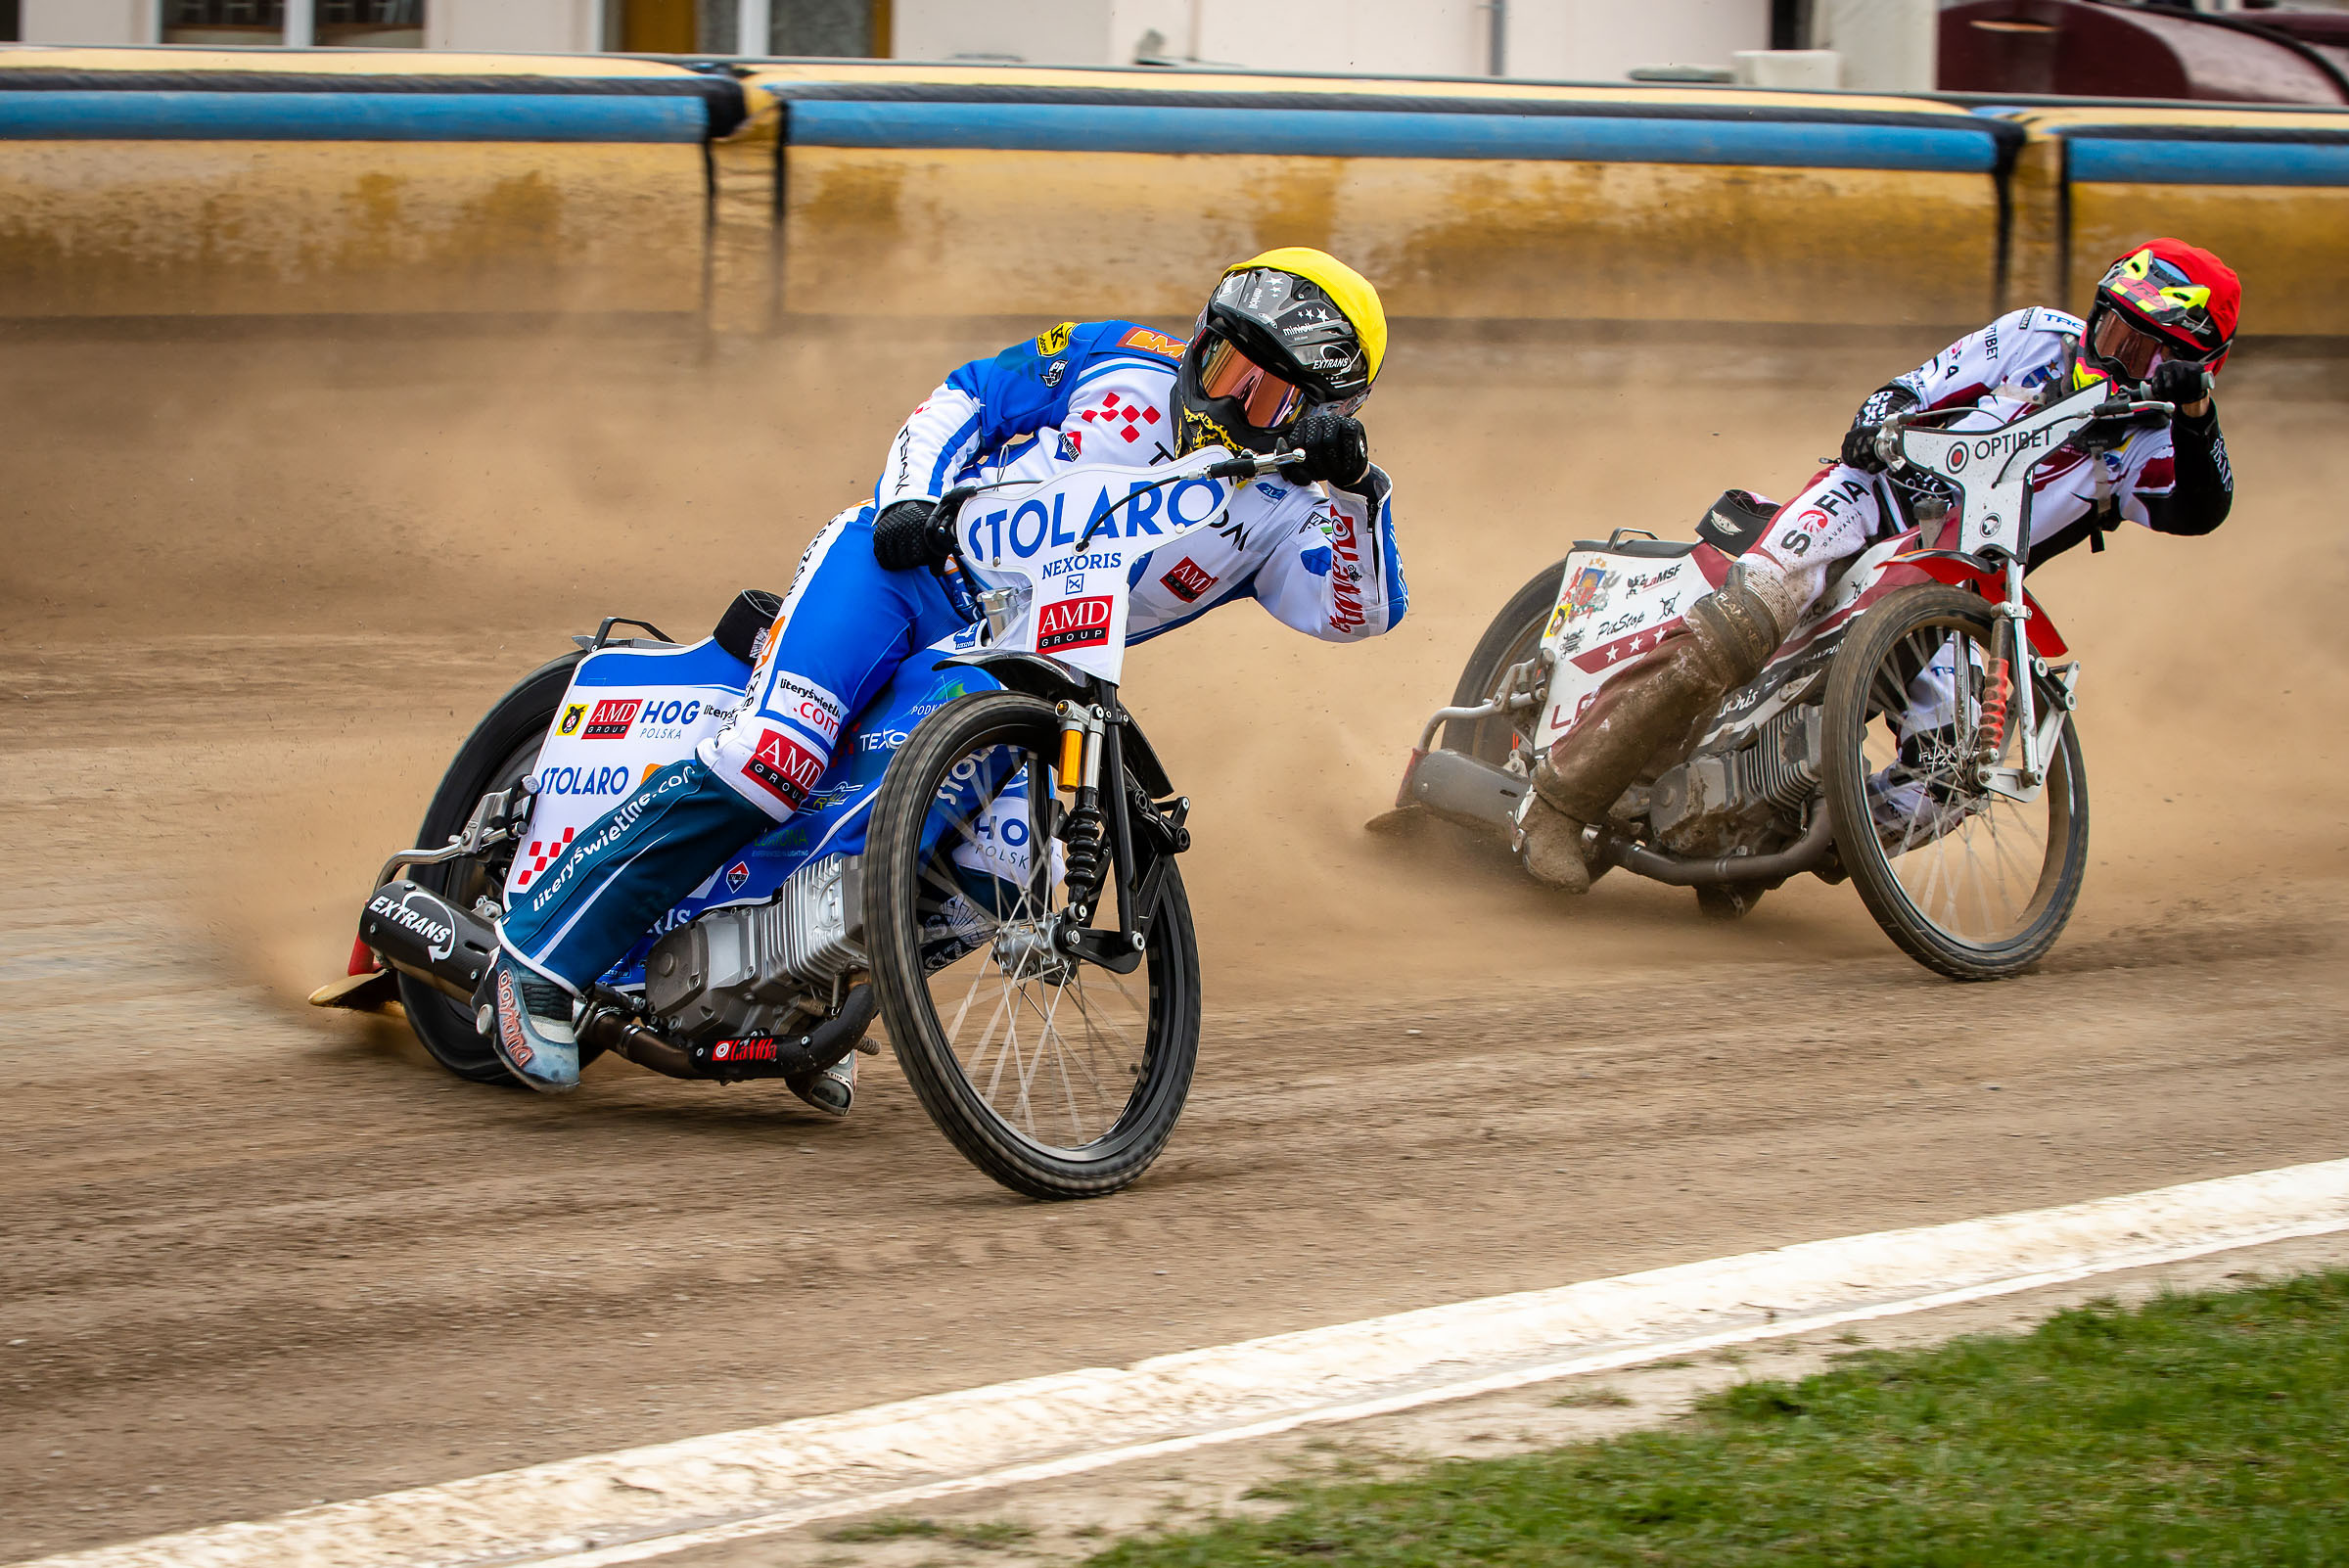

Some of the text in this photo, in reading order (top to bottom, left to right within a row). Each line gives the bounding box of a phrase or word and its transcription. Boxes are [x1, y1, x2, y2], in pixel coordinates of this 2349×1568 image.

[1984, 324, 1999, 361] TIBET
[1312, 357, 1349, 370] EXTRANS
[1974, 426, 2053, 460] OPTIBET
[968, 474, 1225, 562] STOLARO
[1041, 551, 1123, 579] NEXORIS
[1174, 564, 1213, 593] AMD
[1040, 601, 1110, 634] AMD
[1041, 629, 1103, 648] GROUP
[590, 702, 639, 723] AMD
[639, 699, 702, 725] HOG
[586, 725, 627, 734] GROUP
[639, 727, 682, 740] POLSKA
[758, 737, 822, 791] AMD
[538, 765, 630, 796] STOLARO
[975, 843, 1031, 871] POLSK
[368, 895, 452, 945] EXTRANS
